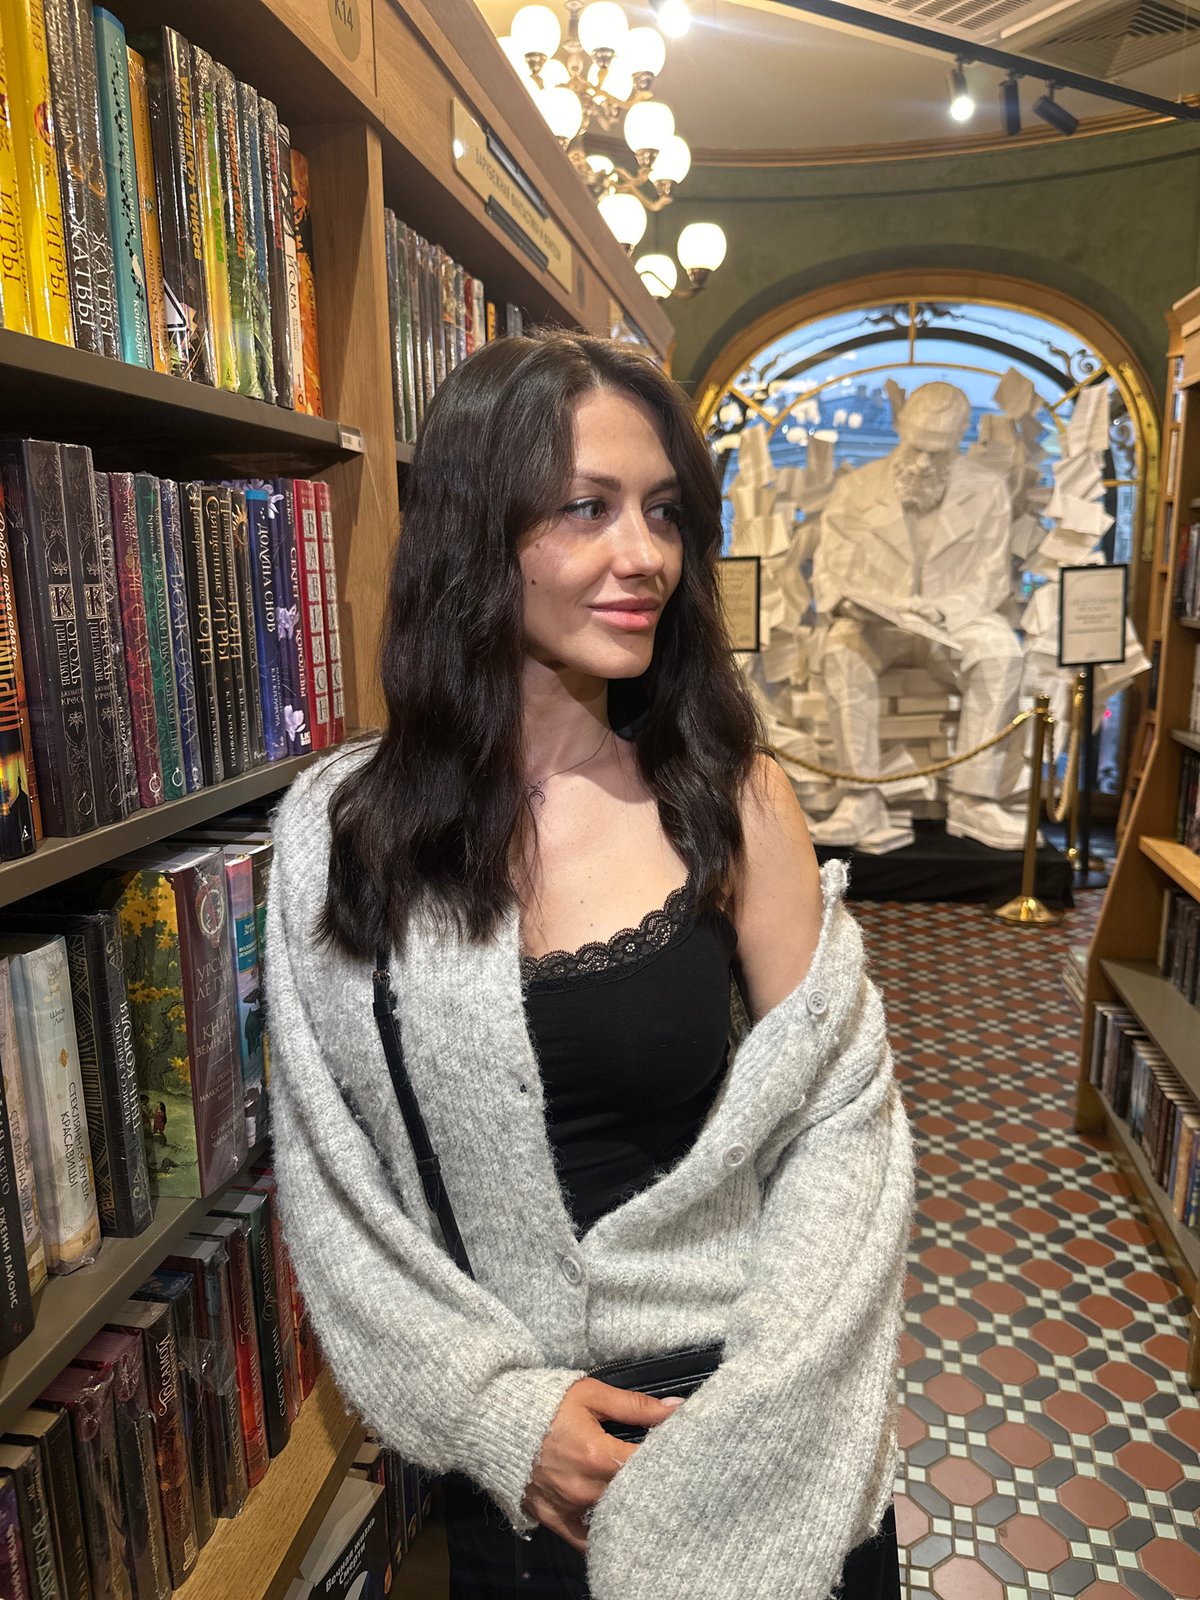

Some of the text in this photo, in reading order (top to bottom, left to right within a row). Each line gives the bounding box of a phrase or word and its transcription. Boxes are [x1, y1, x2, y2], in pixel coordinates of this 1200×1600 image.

[117, 61, 127, 108] СТРАНА
[122, 113, 134, 195] ПОТЕРЯННЫХ
[181, 76, 204, 261] ВОЙНА КАЛИБАНА
[1, 191, 20, 283] ИГРЫ
[47, 213, 66, 299] ИГРЫ
[233, 190, 247, 259] ПОЖАР
[69, 216, 95, 328] ЖАТВЫ
[92, 232, 113, 339] ЖАТВЫ
[286, 254, 299, 310] ИСКРА
[147, 514, 155, 546] Кросс
[154, 569, 168, 632] ВЕДЬМАМ
[170, 574, 188, 640] ВОЛК
[206, 496, 229, 661] Священные ИГРЫ
[257, 522, 277, 632] ДОЛИНА СНОВ
[2, 573, 18, 661] пожаловать
[197, 603, 213, 665] БОГИ
[228, 601, 242, 659] БОГИ
[290, 547, 307, 697] СЕКРЕТ КОРОЛЕВЫ
[53, 622, 72, 686] ПРИЗРАКОВ
[88, 622, 104, 682] ПРИЗРАКОВ
[174, 648, 197, 745] ОДИЧАЛ
[211, 720, 222, 775] КРОУФОРД
[228, 715, 236, 768] КРОУФОРД
[241, 709, 250, 765] КРОУФОРД
[197, 951, 229, 982] УРСУЛ
[202, 1003, 235, 1041] КНИГ
[113, 1020, 133, 1126] МЕЛИССА ЛАНДЕРС
[119, 1001, 141, 1134] ТЕНЬ КОРОЛЯ
[10, 1110, 32, 1238] СТЕКЛЯННАЯ ДУША
[60, 1111, 79, 1188] КРАСАВИЦЫ
[69, 1081, 90, 1202] СТЕКЛЯННАЯ ДУША
[4, 1256, 19, 1309] ЛАЙОНС
[155, 1333, 174, 1390] САМОЙ
[250, 1352, 260, 1396] ЛИНЧ
[271, 1326, 287, 1416] СКОТТ ЛИНЧ
[231, 1432, 243, 1478] СКОТТ
[326, 1548, 354, 1593] Вечная
[353, 1517, 376, 1553] жизнь
[339, 1541, 366, 1585] Смерти
